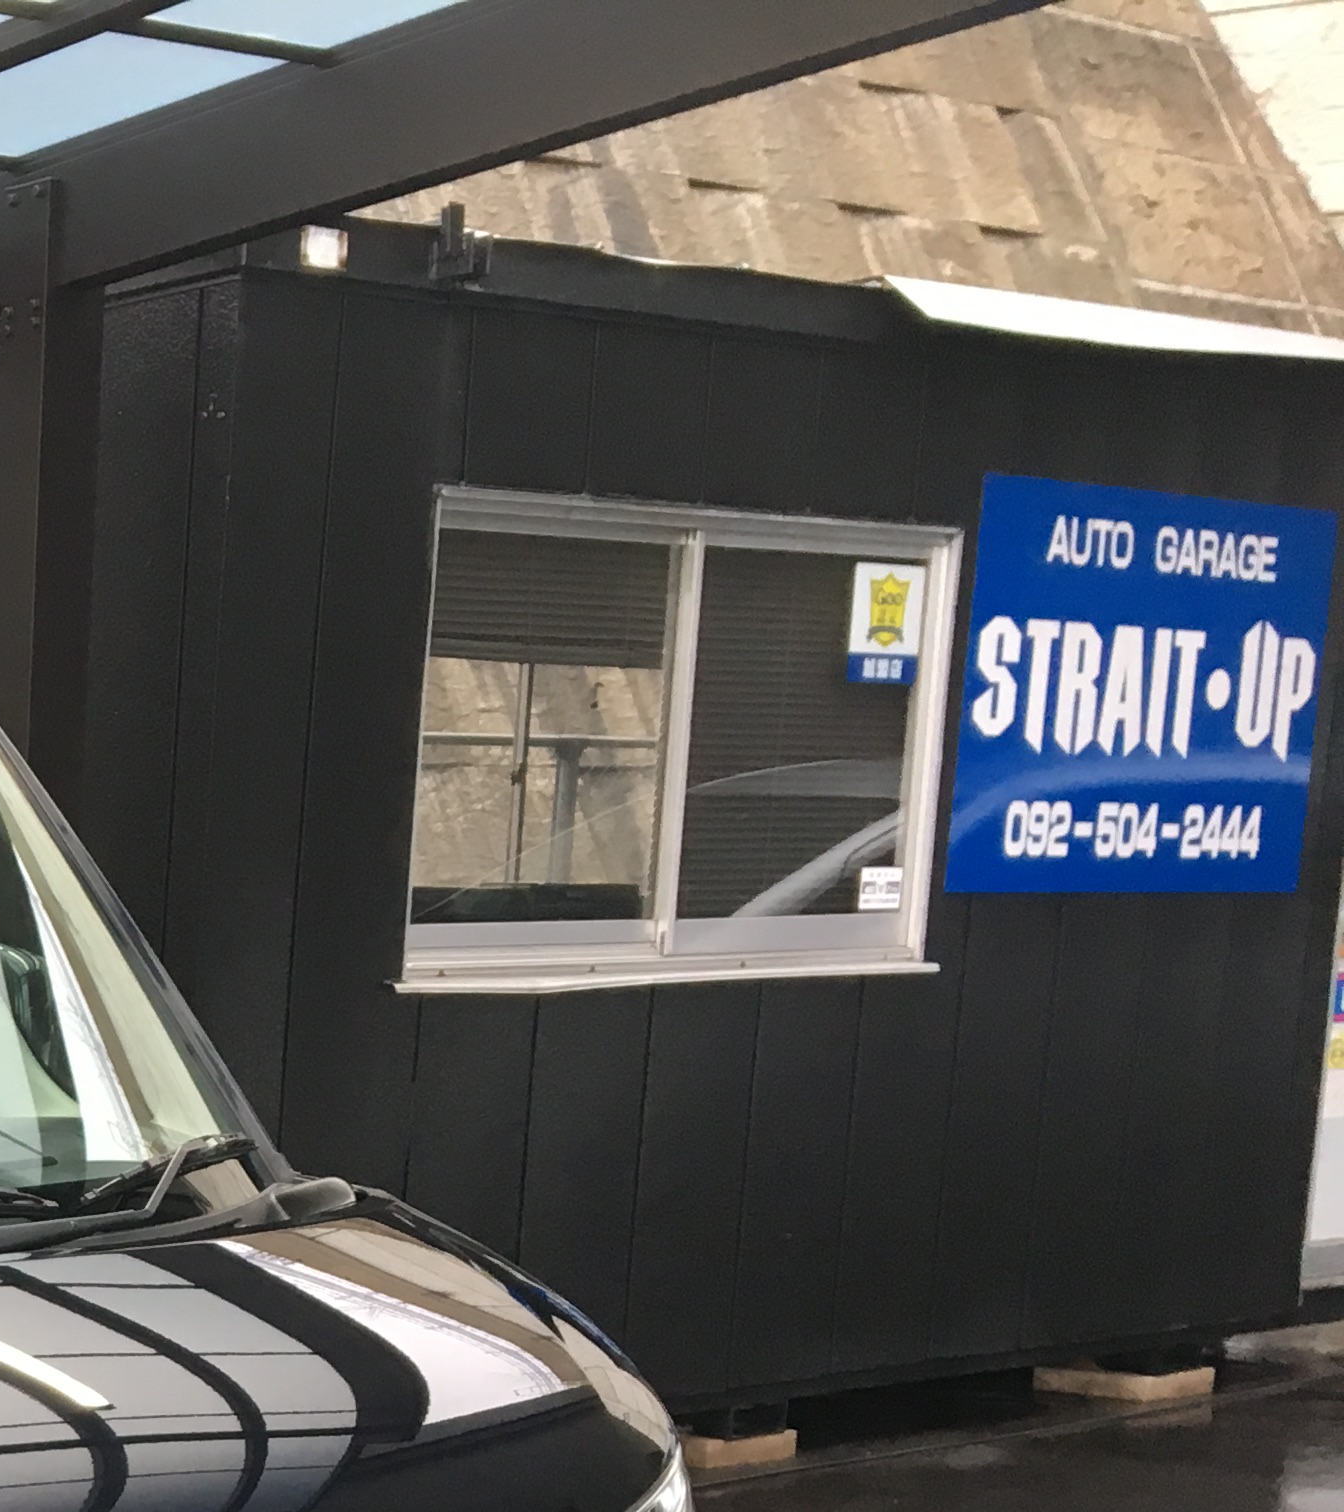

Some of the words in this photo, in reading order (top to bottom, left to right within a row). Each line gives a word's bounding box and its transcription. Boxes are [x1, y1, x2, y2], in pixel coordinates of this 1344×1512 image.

[1046, 515, 1135, 570] AUTO
[1155, 526, 1279, 583] GARAGE
[1003, 800, 1263, 860] 092-504-2444
